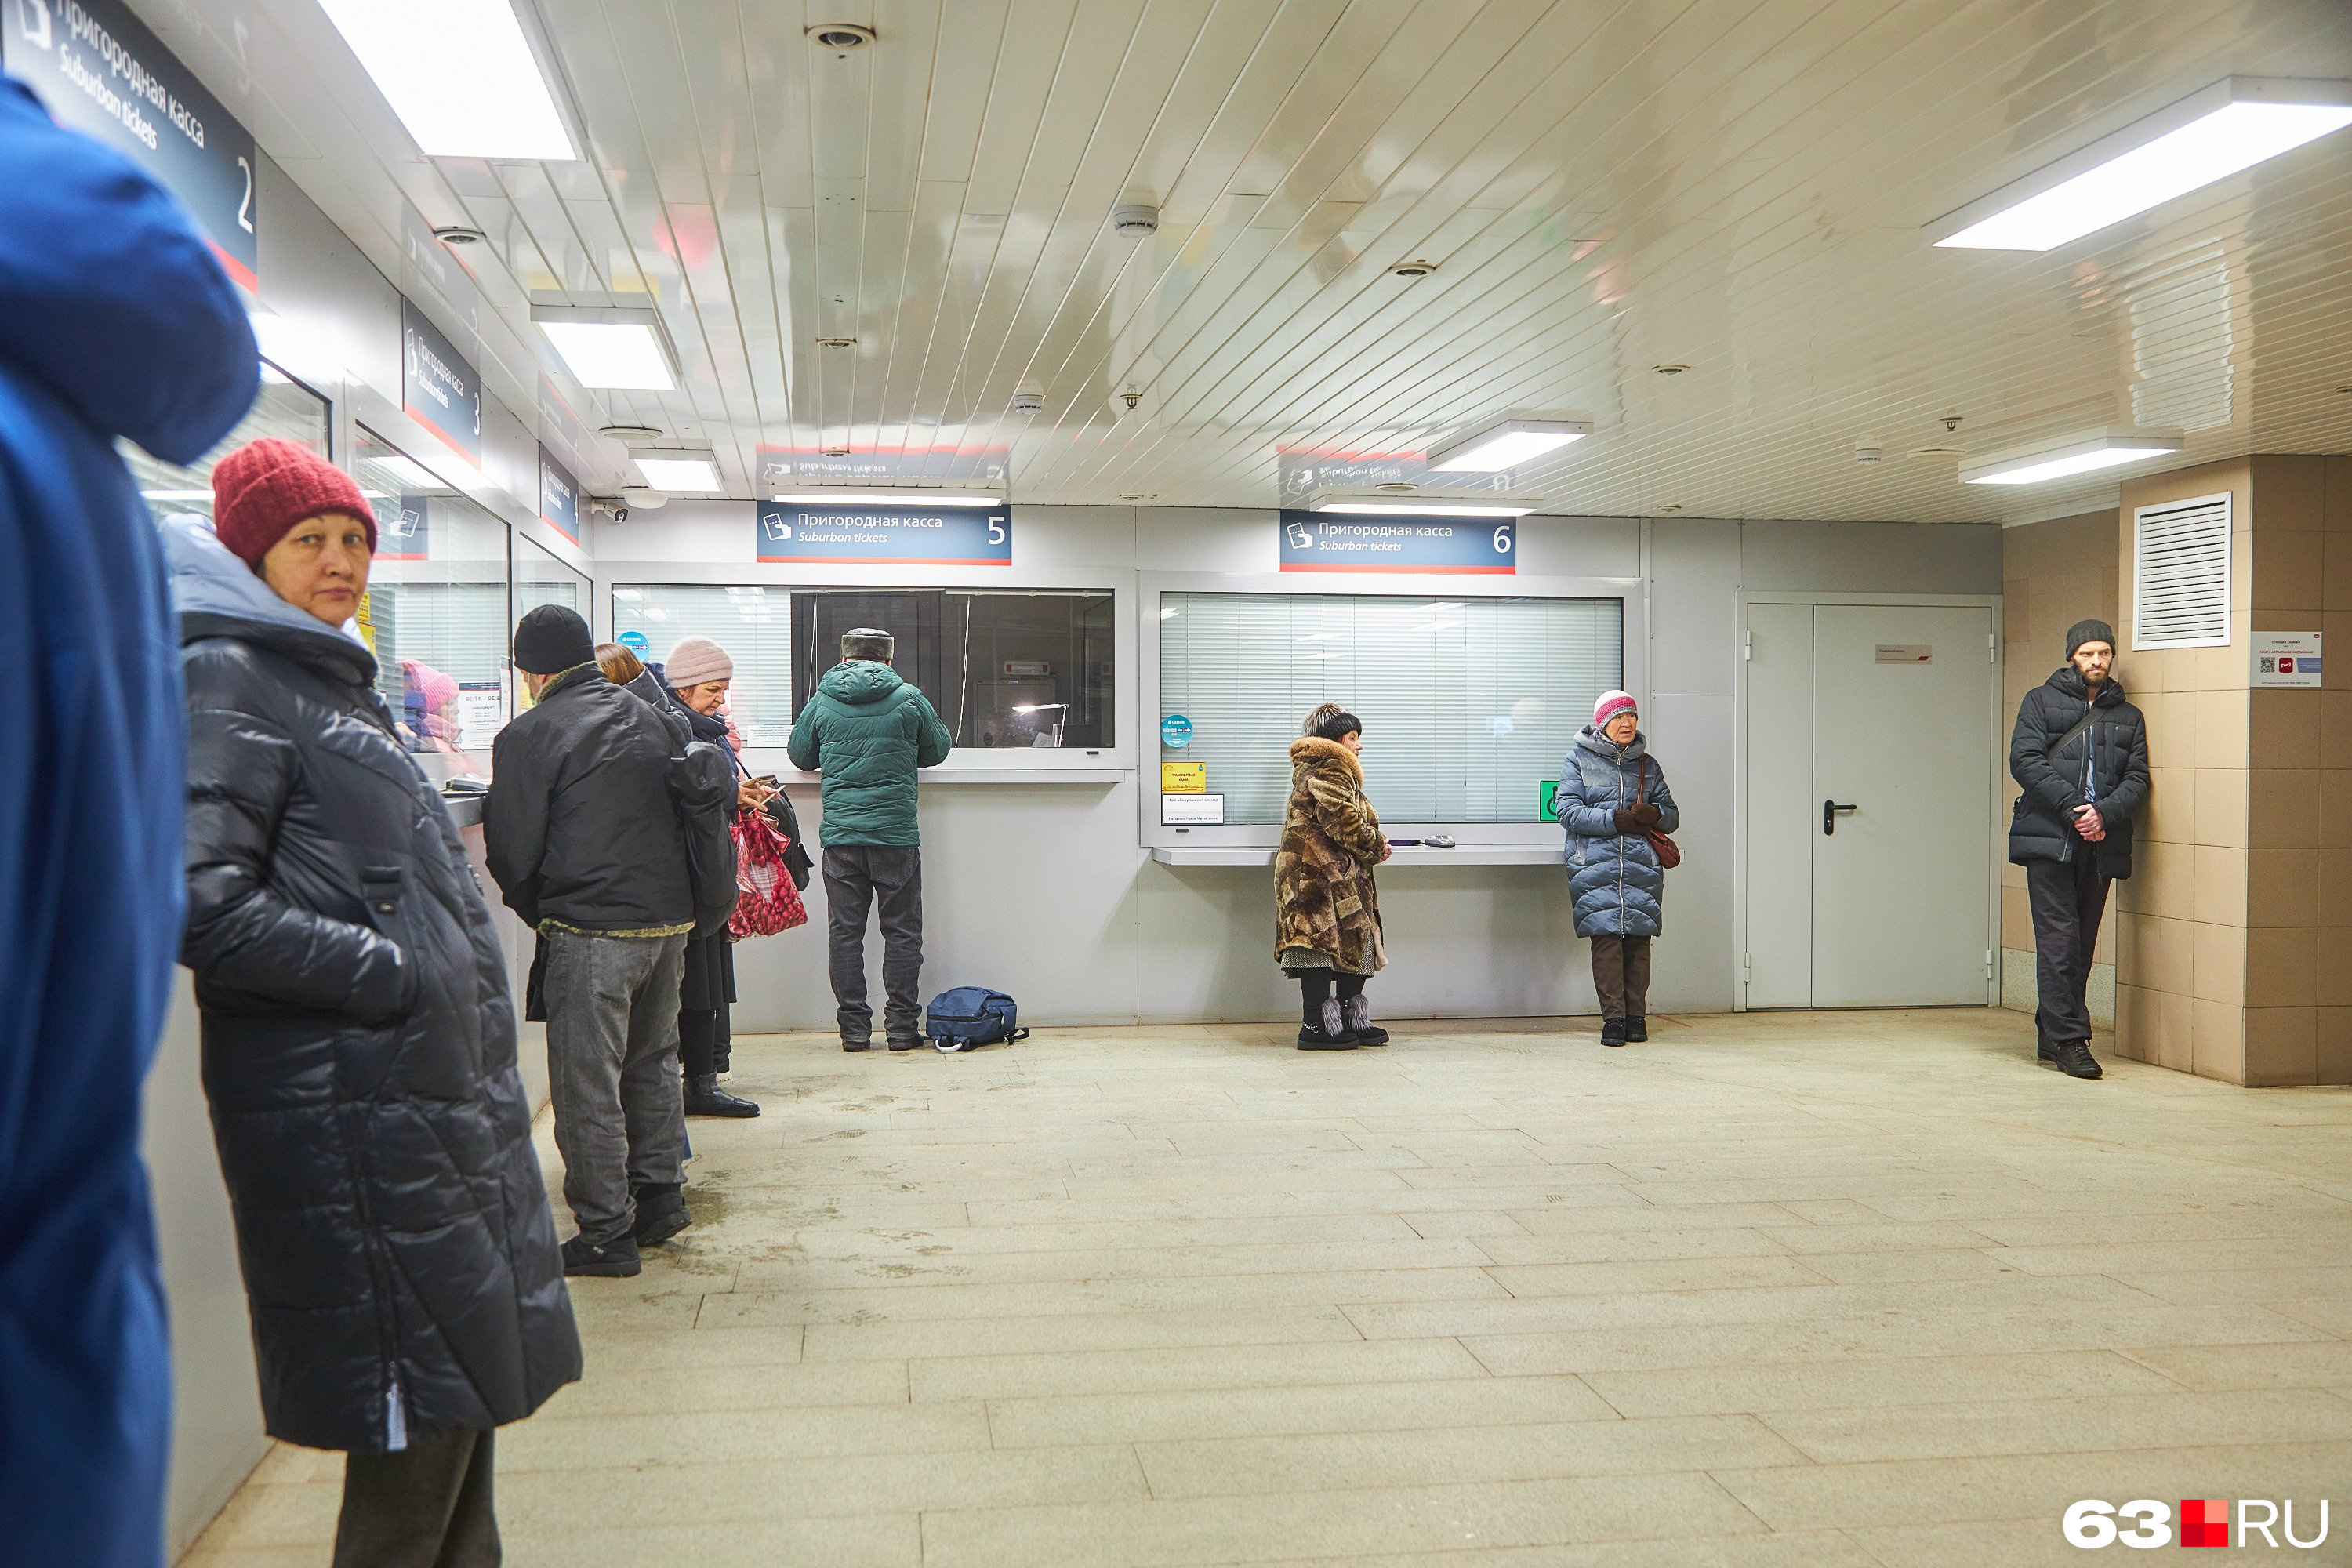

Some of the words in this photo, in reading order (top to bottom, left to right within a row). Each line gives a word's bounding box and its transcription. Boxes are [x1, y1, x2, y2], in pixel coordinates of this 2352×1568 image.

[60, 42, 121, 119] Suburban
[121, 100, 157, 150] tickets
[168, 95, 205, 149] касса
[238, 156, 253, 234] 2
[474, 392, 481, 437] 3
[574, 493, 579, 524] 4
[798, 513, 899, 529] Пригородная
[903, 517, 942, 528] касса
[798, 532, 851, 543] Suburban
[853, 532, 887, 543] tickets
[988, 517, 1006, 545] 5
[1319, 523, 1412, 538] Пригородная
[1416, 525, 1453, 536] касса
[1493, 526, 1512, 554] 6
[1319, 541, 1368, 551] Suburban
[1370, 541, 1402, 551] tickets
